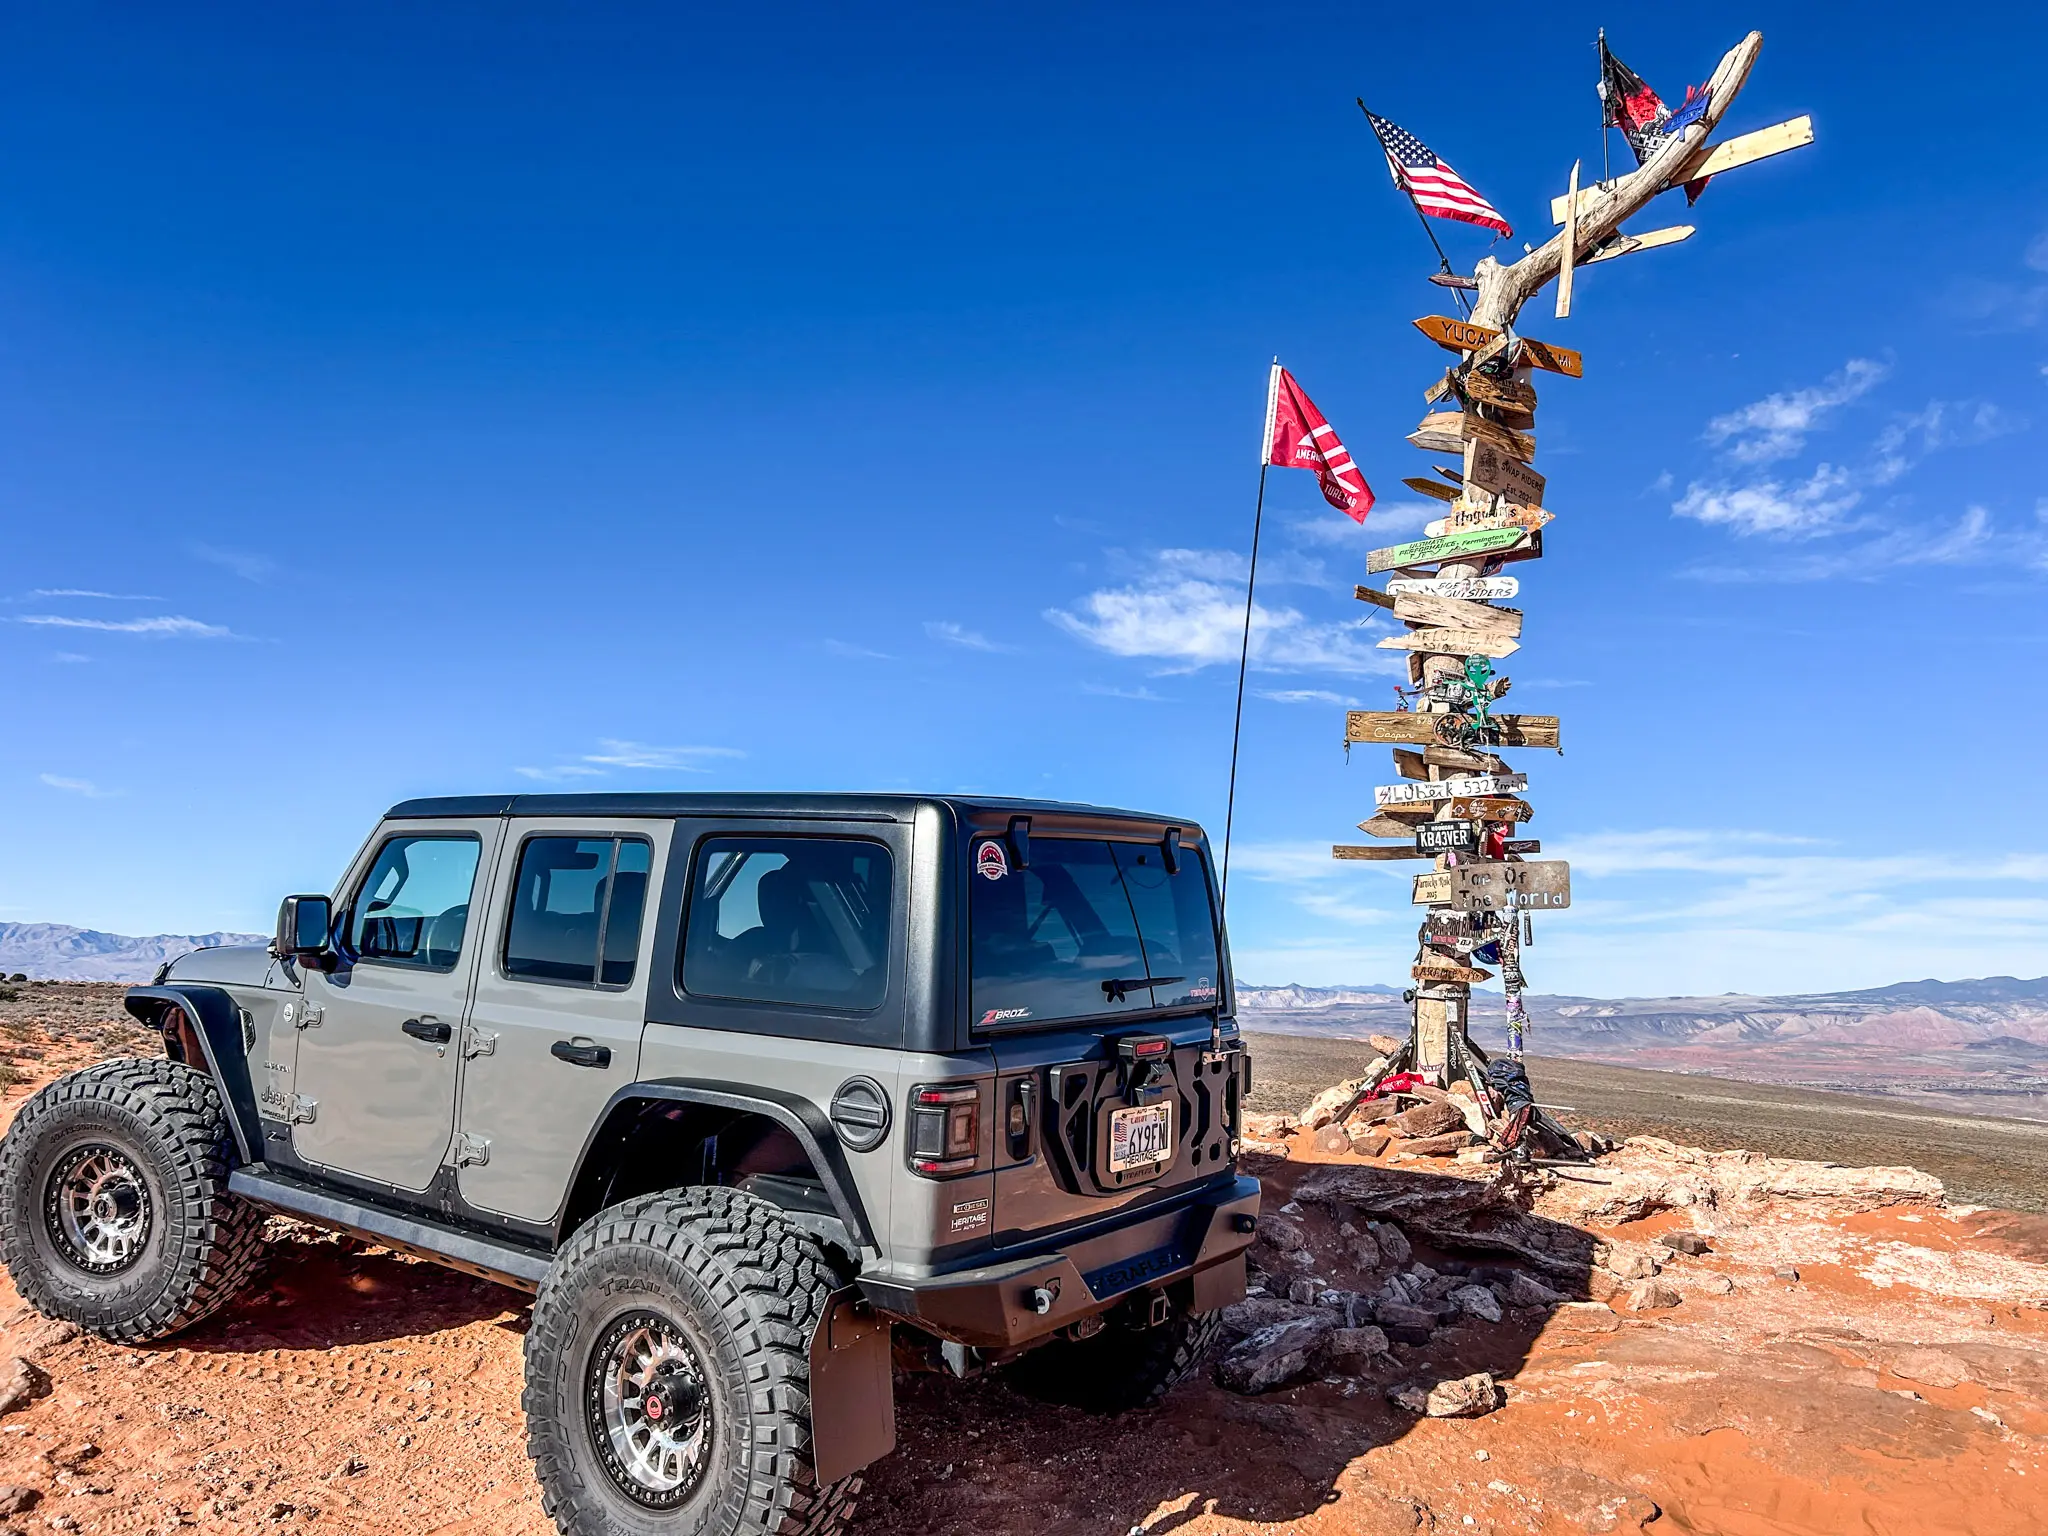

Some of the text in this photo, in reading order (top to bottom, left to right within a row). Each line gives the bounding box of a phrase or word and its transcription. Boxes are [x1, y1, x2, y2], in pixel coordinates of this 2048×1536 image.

[1501, 461, 1543, 492] SWAP RIDERS
[1374, 727, 1414, 741] Casper
[1420, 830, 1468, 847] KB43VER
[1459, 866, 1528, 886] Top Of
[1458, 887, 1562, 908] The World
[1125, 1150, 1158, 1168] HERITAGE
[951, 1212, 987, 1229] HERITAGE
[598, 1277, 665, 1298] TRAIL
